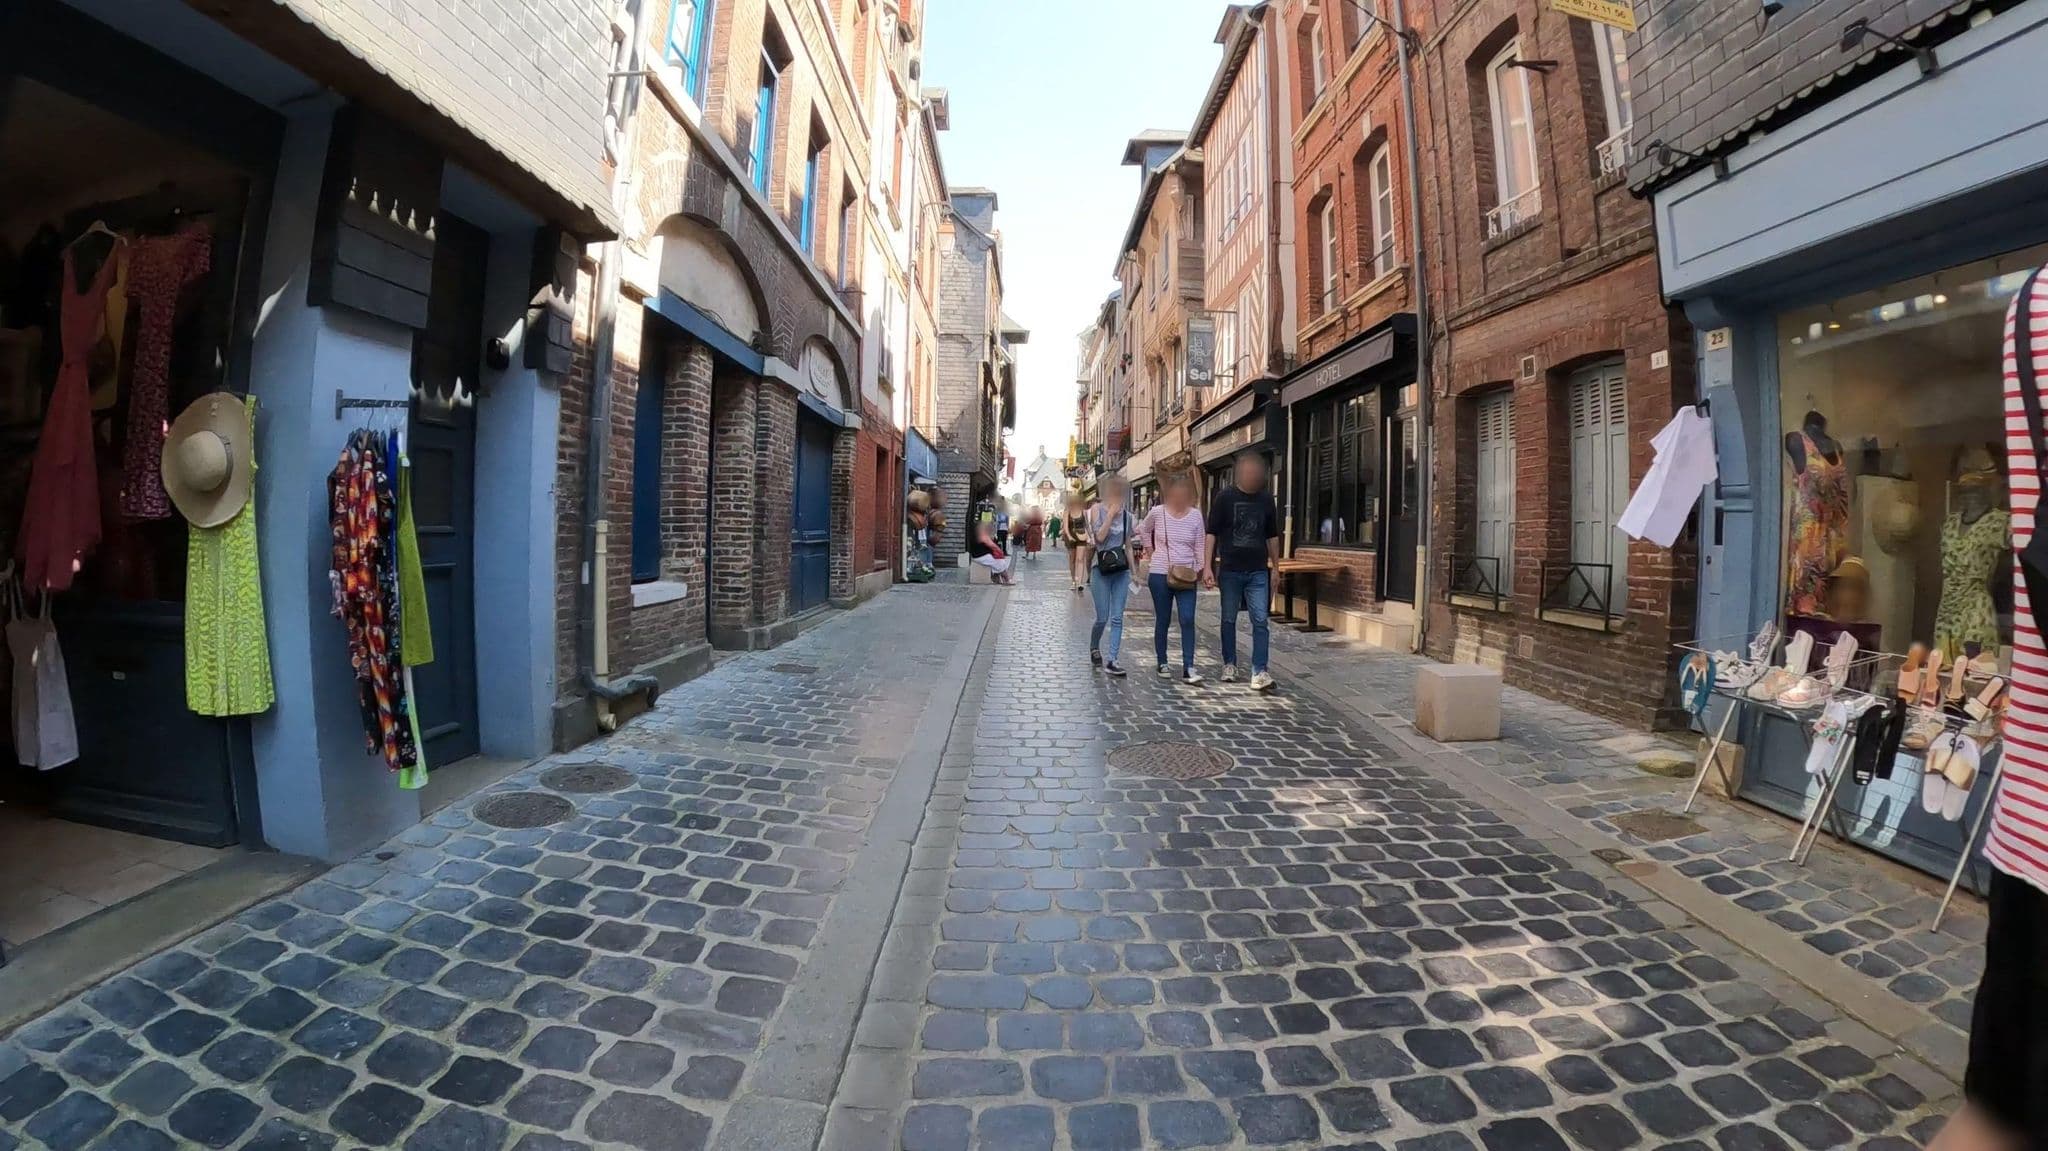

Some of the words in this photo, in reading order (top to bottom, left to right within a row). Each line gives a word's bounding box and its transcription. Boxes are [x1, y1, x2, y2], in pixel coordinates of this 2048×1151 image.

[1587, 0, 1598, 10] 72
[1711, 332, 1723, 345] 23
[1189, 368, 1212, 381] Sel
[1315, 363, 1342, 389] HOTEL
